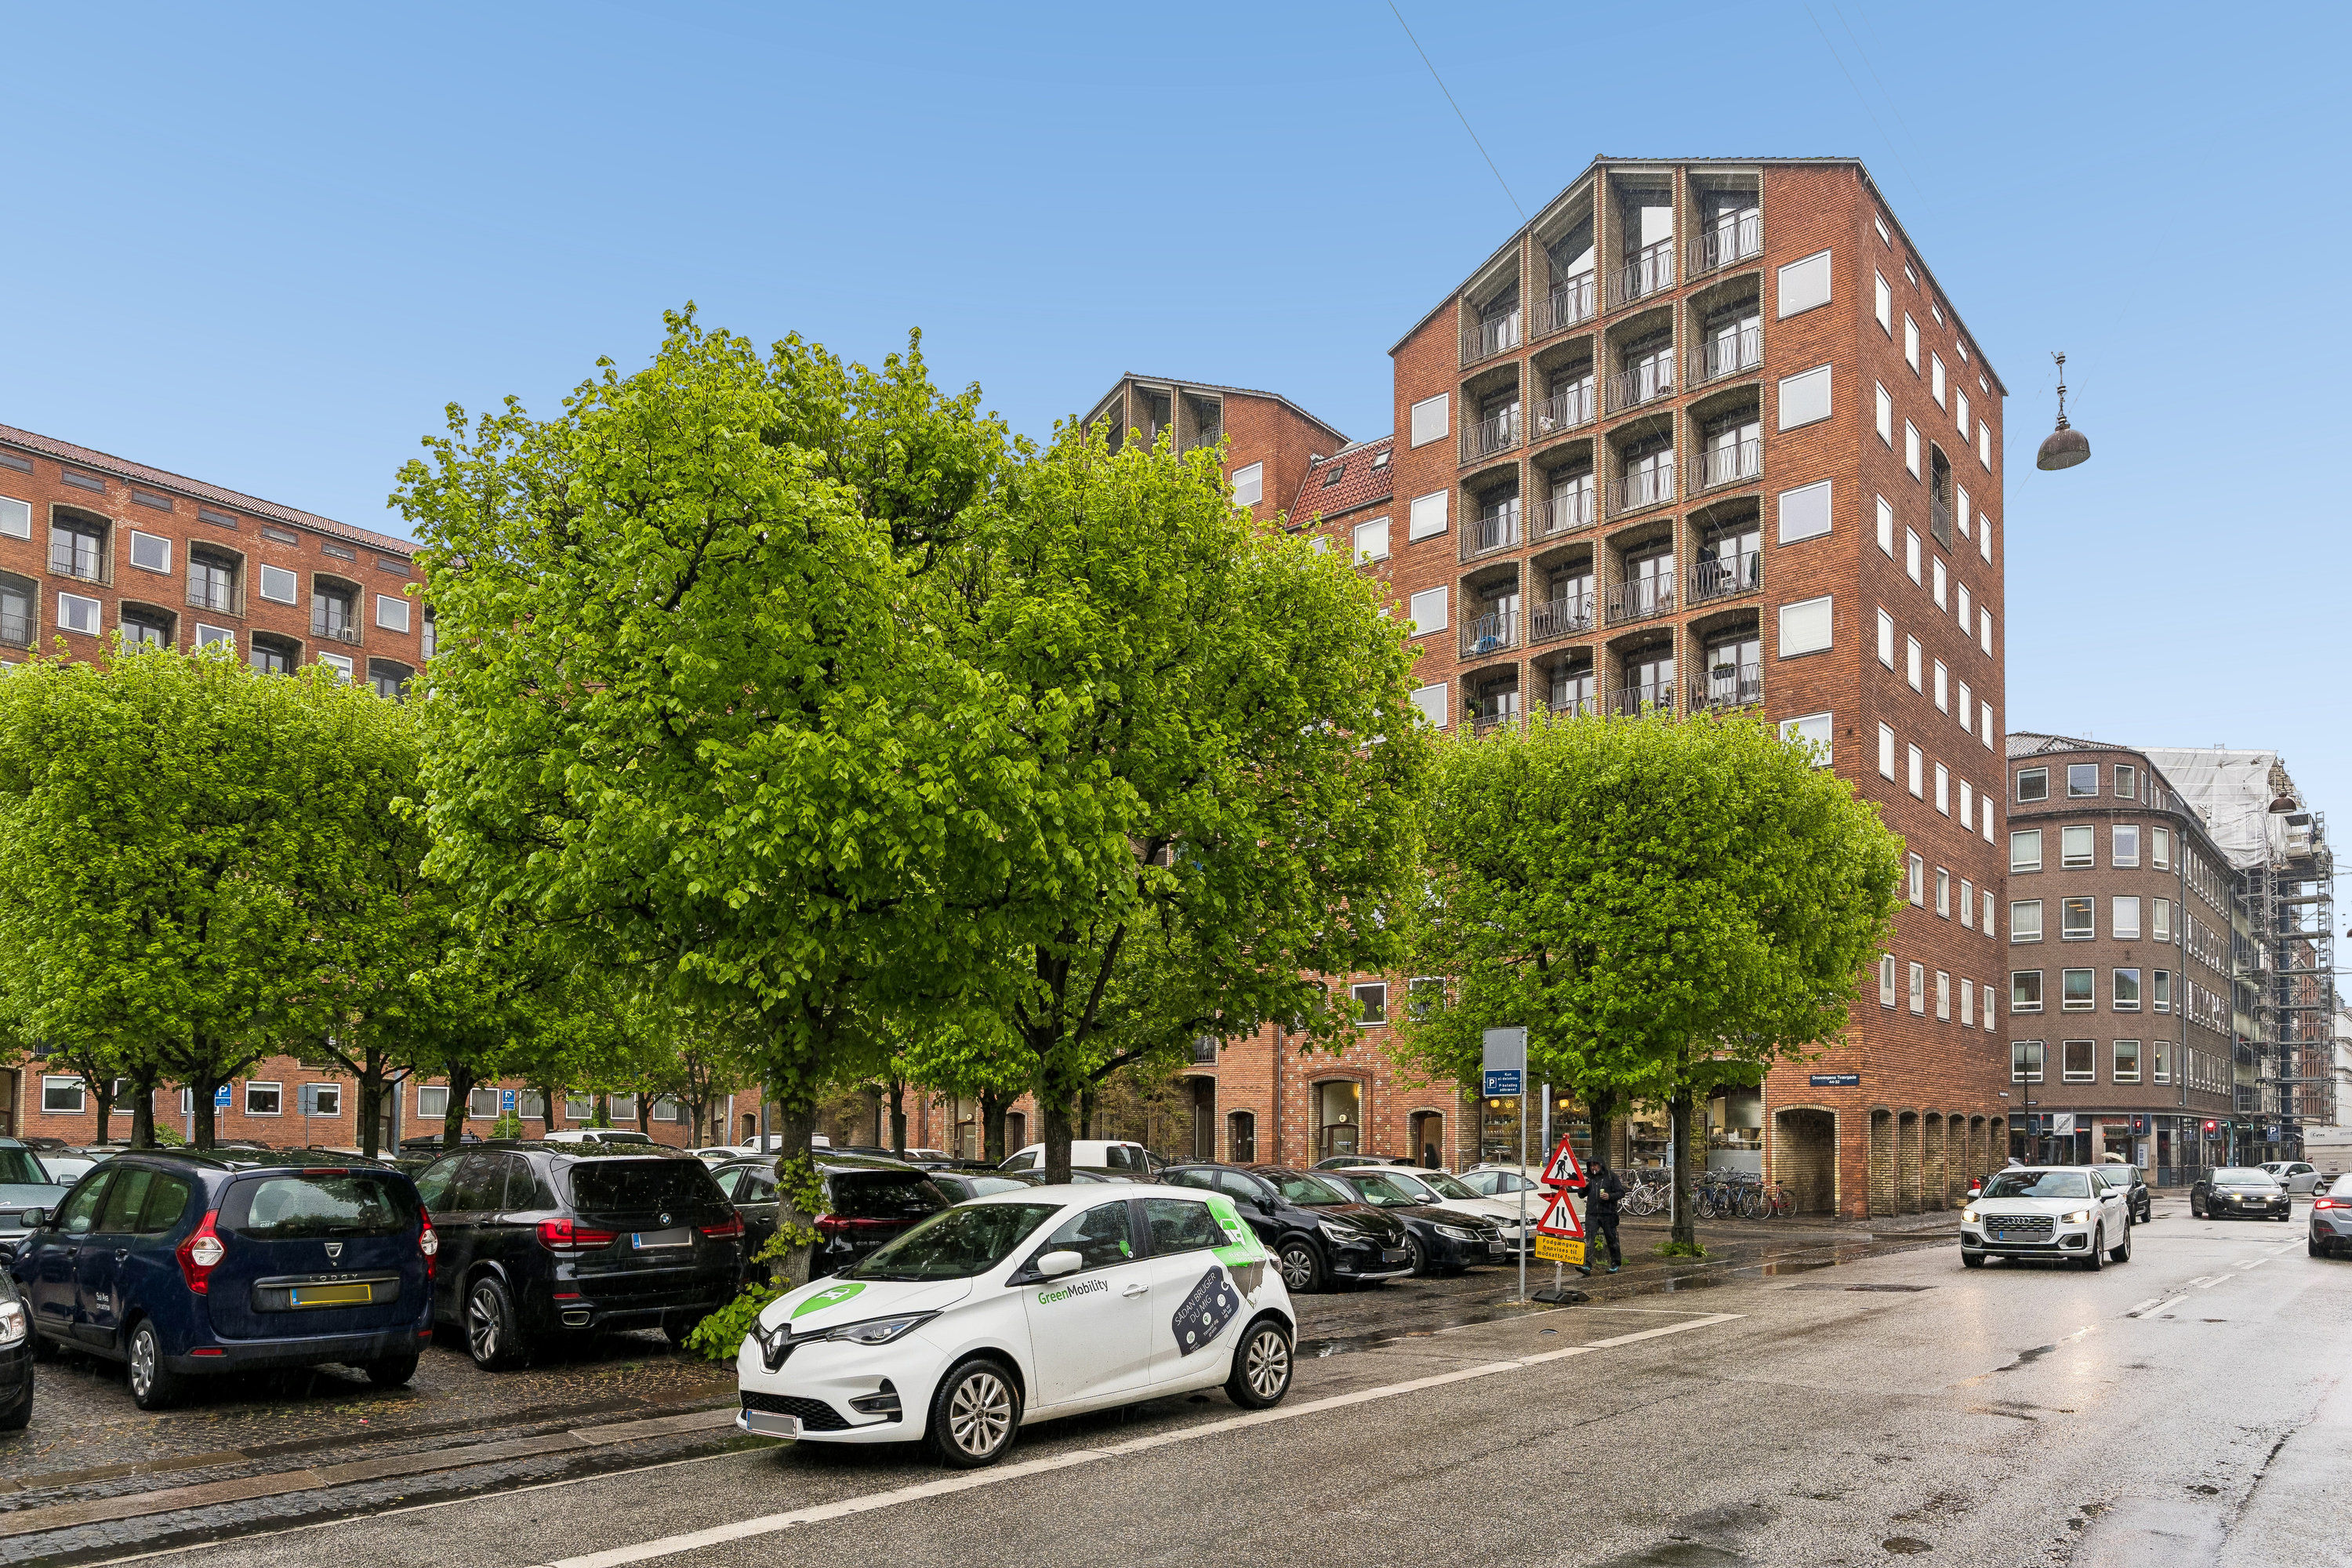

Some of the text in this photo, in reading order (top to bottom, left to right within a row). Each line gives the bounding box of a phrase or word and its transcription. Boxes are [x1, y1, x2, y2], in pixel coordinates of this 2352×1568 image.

[1489, 1079, 1495, 1087] P
[218, 1085, 228, 1097] P
[1542, 1238, 1578, 1249] Fodgængere
[1543, 1244, 1569, 1254] henvises
[1537, 1250, 1563, 1259] modsatte
[309, 1273, 358, 1282] LODGY
[1037, 1279, 1109, 1305] GreenMobility
[1174, 1298, 1196, 1327] SÅDAN
[1193, 1272, 1217, 1303] BRUGER
[1189, 1294, 1213, 1323] DU MIG
